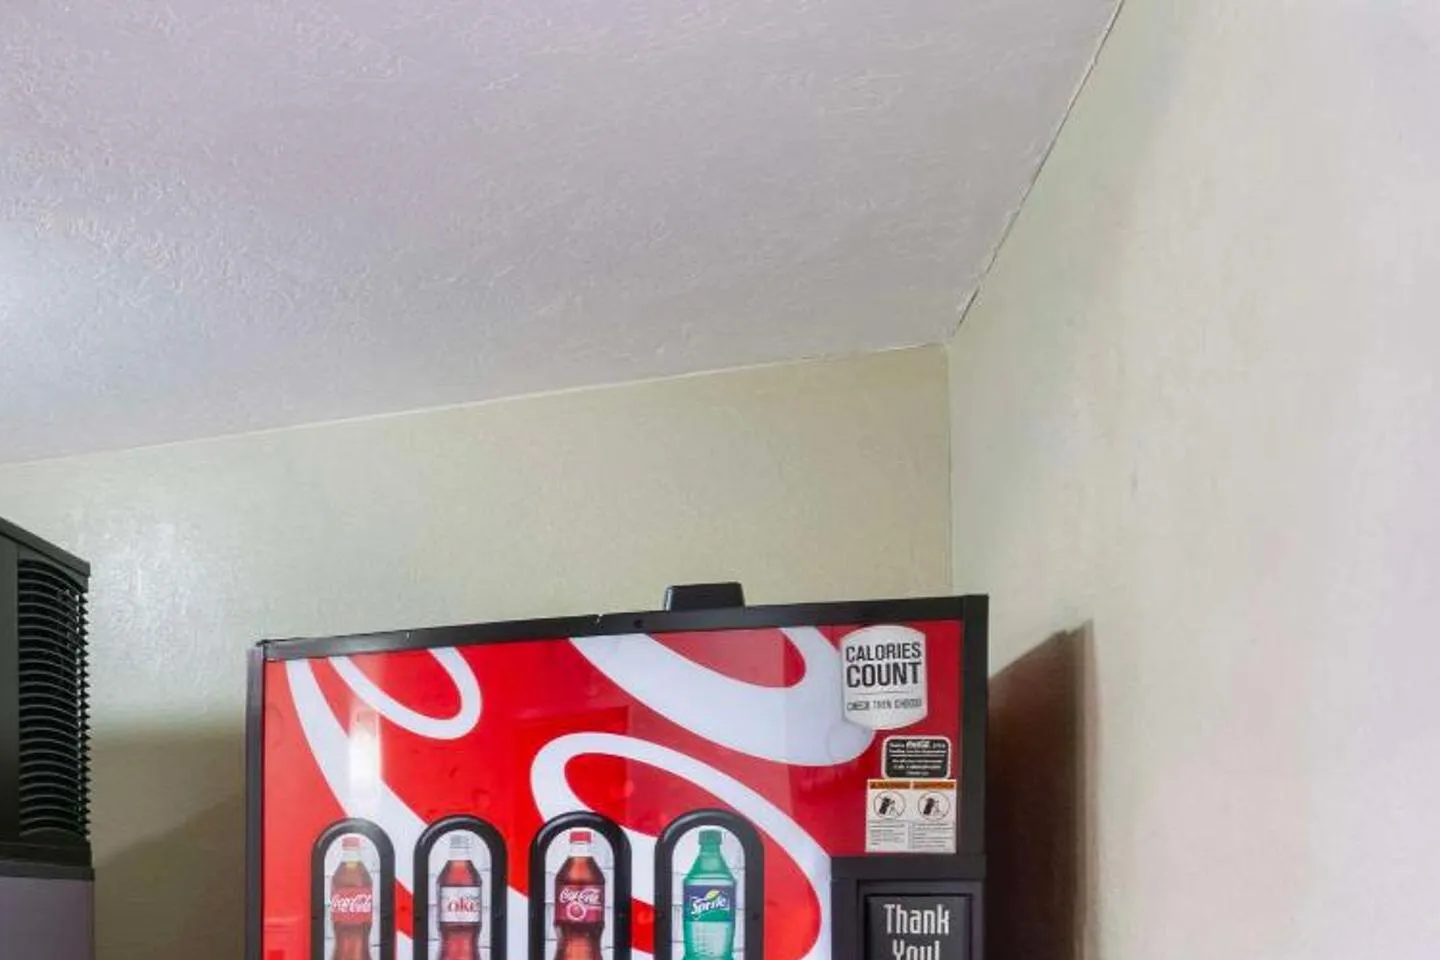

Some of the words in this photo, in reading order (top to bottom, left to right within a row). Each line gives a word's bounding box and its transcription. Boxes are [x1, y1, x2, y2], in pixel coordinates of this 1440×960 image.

[846, 642, 922, 662] CALORIES
[846, 662, 922, 688] COUNT
[689, 895, 730, 920] Sprite
[883, 903, 950, 935] Thank
